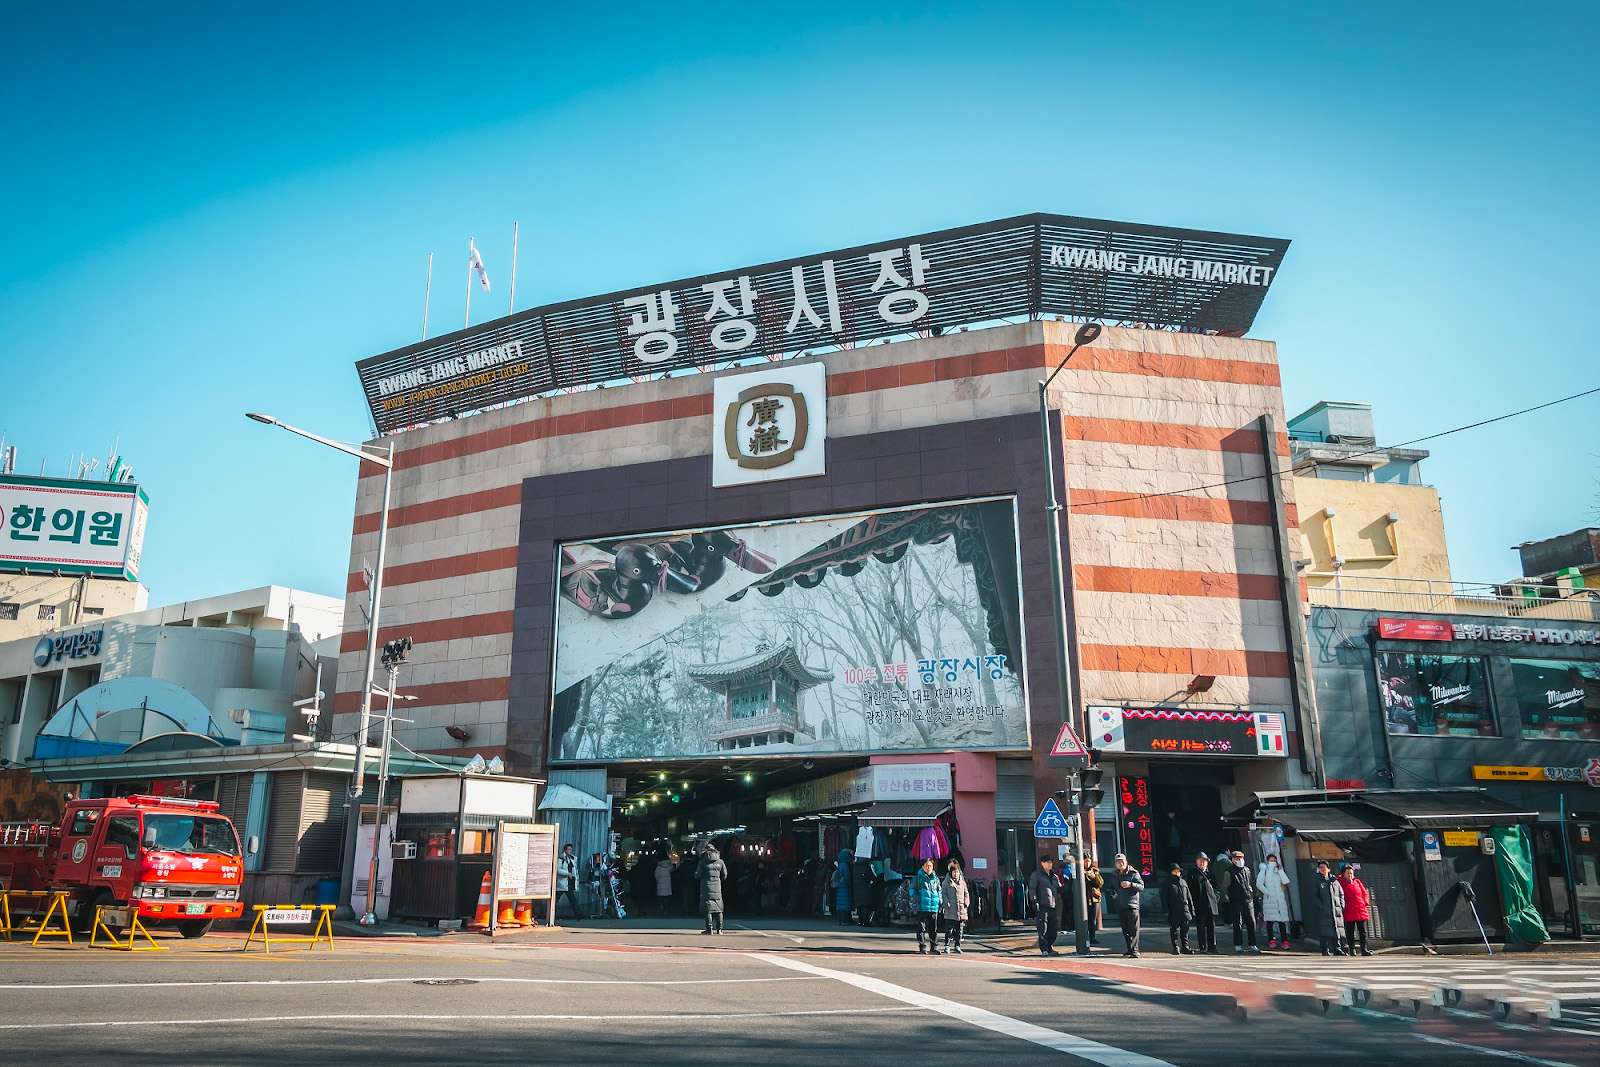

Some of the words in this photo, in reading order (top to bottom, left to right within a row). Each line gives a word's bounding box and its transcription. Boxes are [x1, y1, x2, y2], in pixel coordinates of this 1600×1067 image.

[1050, 245, 1127, 272] KWANG
[1131, 253, 1187, 278] JANG
[1191, 260, 1274, 287] MARKET
[624, 244, 930, 363] 광장시장
[378, 366, 427, 396] KWANG
[426, 355, 465, 380] JANG
[466, 340, 524, 370] MARKET
[10, 504, 123, 547] 한의원
[52, 630, 104, 661] 우리은행
[844, 665, 877, 684] 100年
[883, 664, 909, 684] 전통
[917, 654, 1007, 686] 광장시장
[863, 690, 910, 706] 대한민국의
[912, 689, 931, 703] 대표
[1429, 684, 1472, 701] Milwaukee
[1544, 687, 1585, 706] Milwaukee
